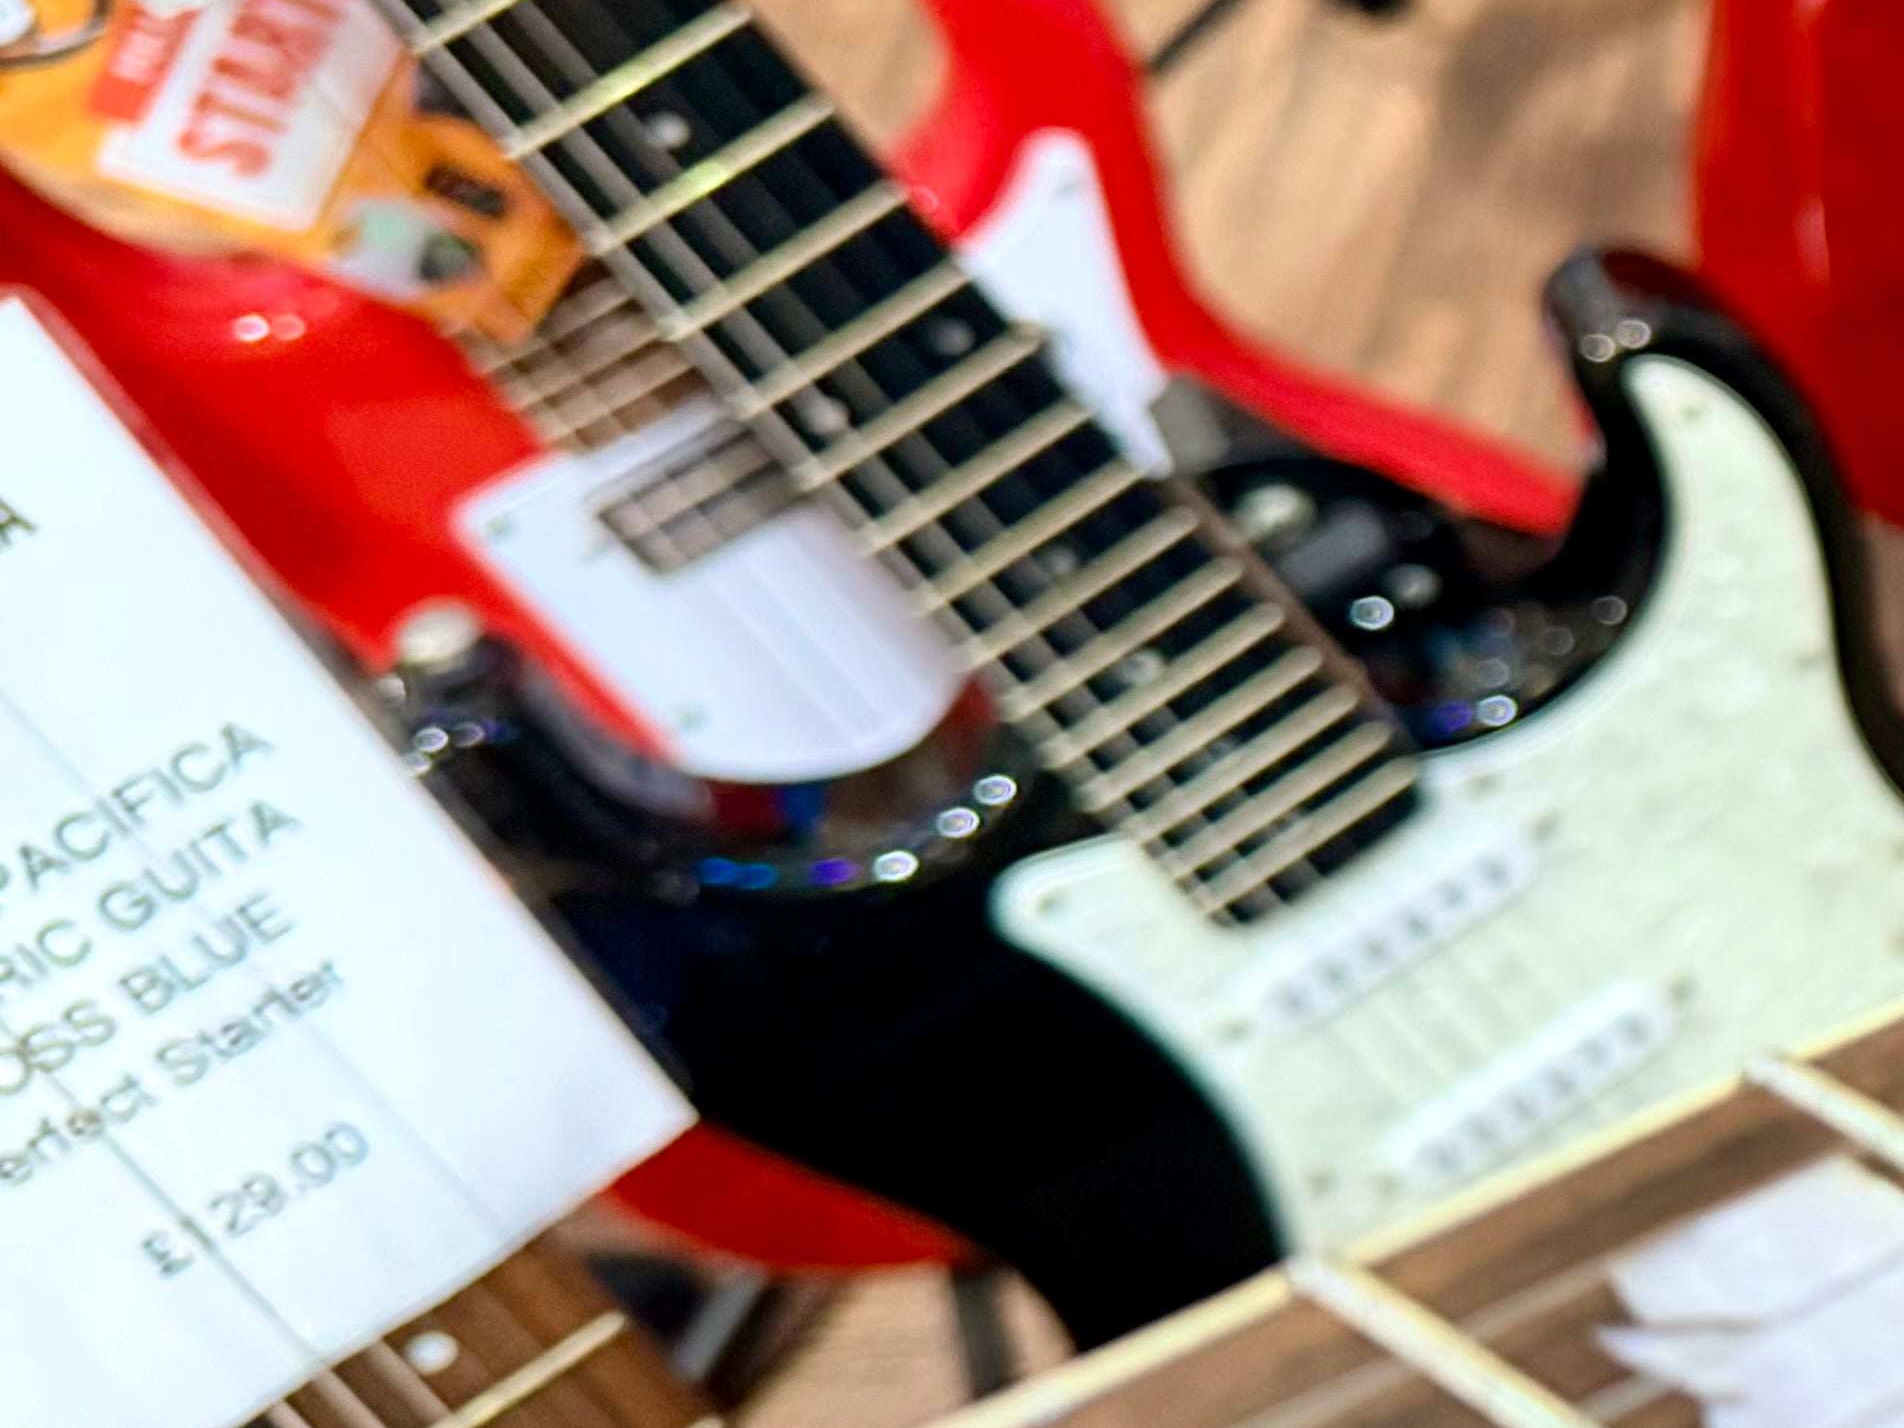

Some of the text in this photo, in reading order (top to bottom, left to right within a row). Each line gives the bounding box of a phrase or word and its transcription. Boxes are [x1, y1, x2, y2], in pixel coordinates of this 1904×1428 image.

[97, 799, 304, 933] GUITA
[118, 890, 295, 1016] BLUE
[154, 956, 347, 1088] Starter
